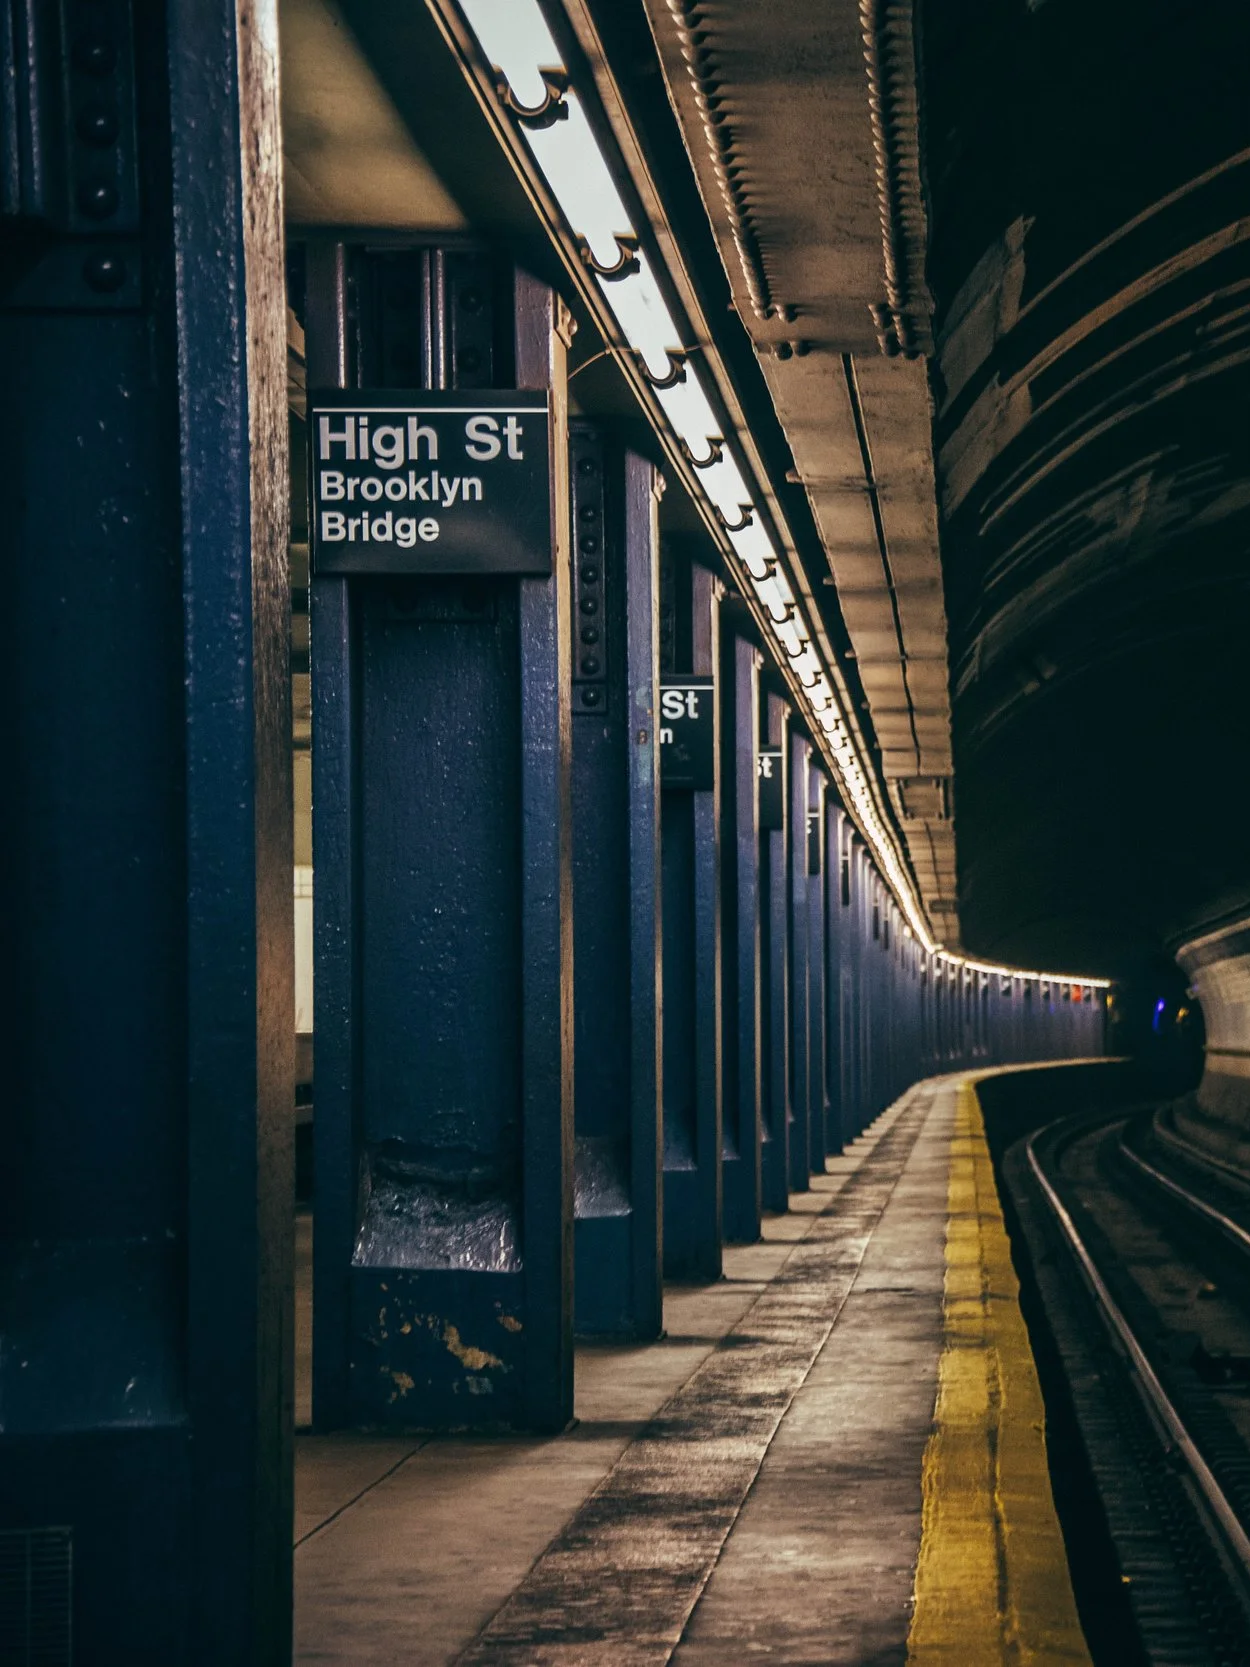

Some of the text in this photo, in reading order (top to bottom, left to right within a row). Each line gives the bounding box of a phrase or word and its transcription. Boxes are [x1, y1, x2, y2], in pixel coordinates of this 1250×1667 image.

[319, 415, 524, 470] High St
[320, 470, 483, 507] Brooklyn
[321, 511, 440, 548] Bridge
[661, 690, 699, 720] St
